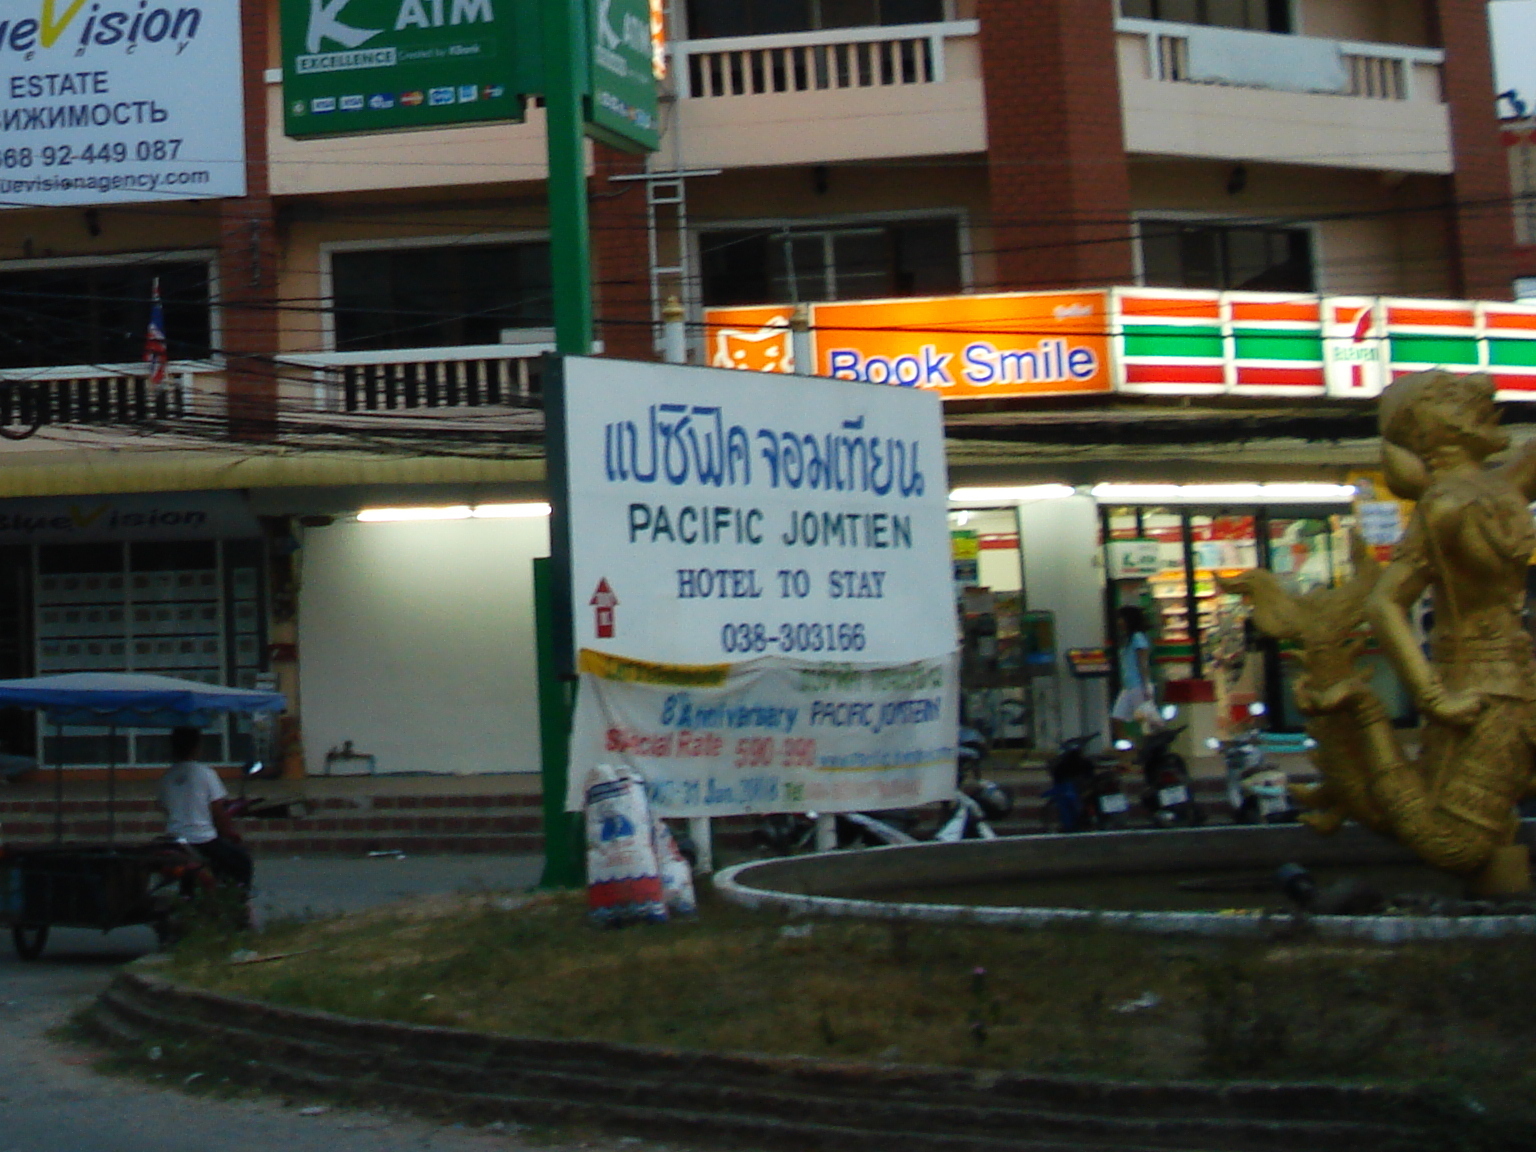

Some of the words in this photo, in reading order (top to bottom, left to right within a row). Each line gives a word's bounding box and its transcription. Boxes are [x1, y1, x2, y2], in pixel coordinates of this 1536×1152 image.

[301, 51, 395, 70] EXCELLENCE
[11, 71, 109, 98] ESTATE
[138, 139, 183, 162] 087
[830, 344, 951, 386] Book
[965, 339, 1095, 383] Smile
[629, 503, 764, 545] PACIFIC
[783, 510, 914, 548] JOMTIEN
[676, 569, 763, 599] HOTEL
[778, 570, 811, 599] TO
[829, 570, 886, 599] STAY
[722, 623, 866, 653] 038-303166
